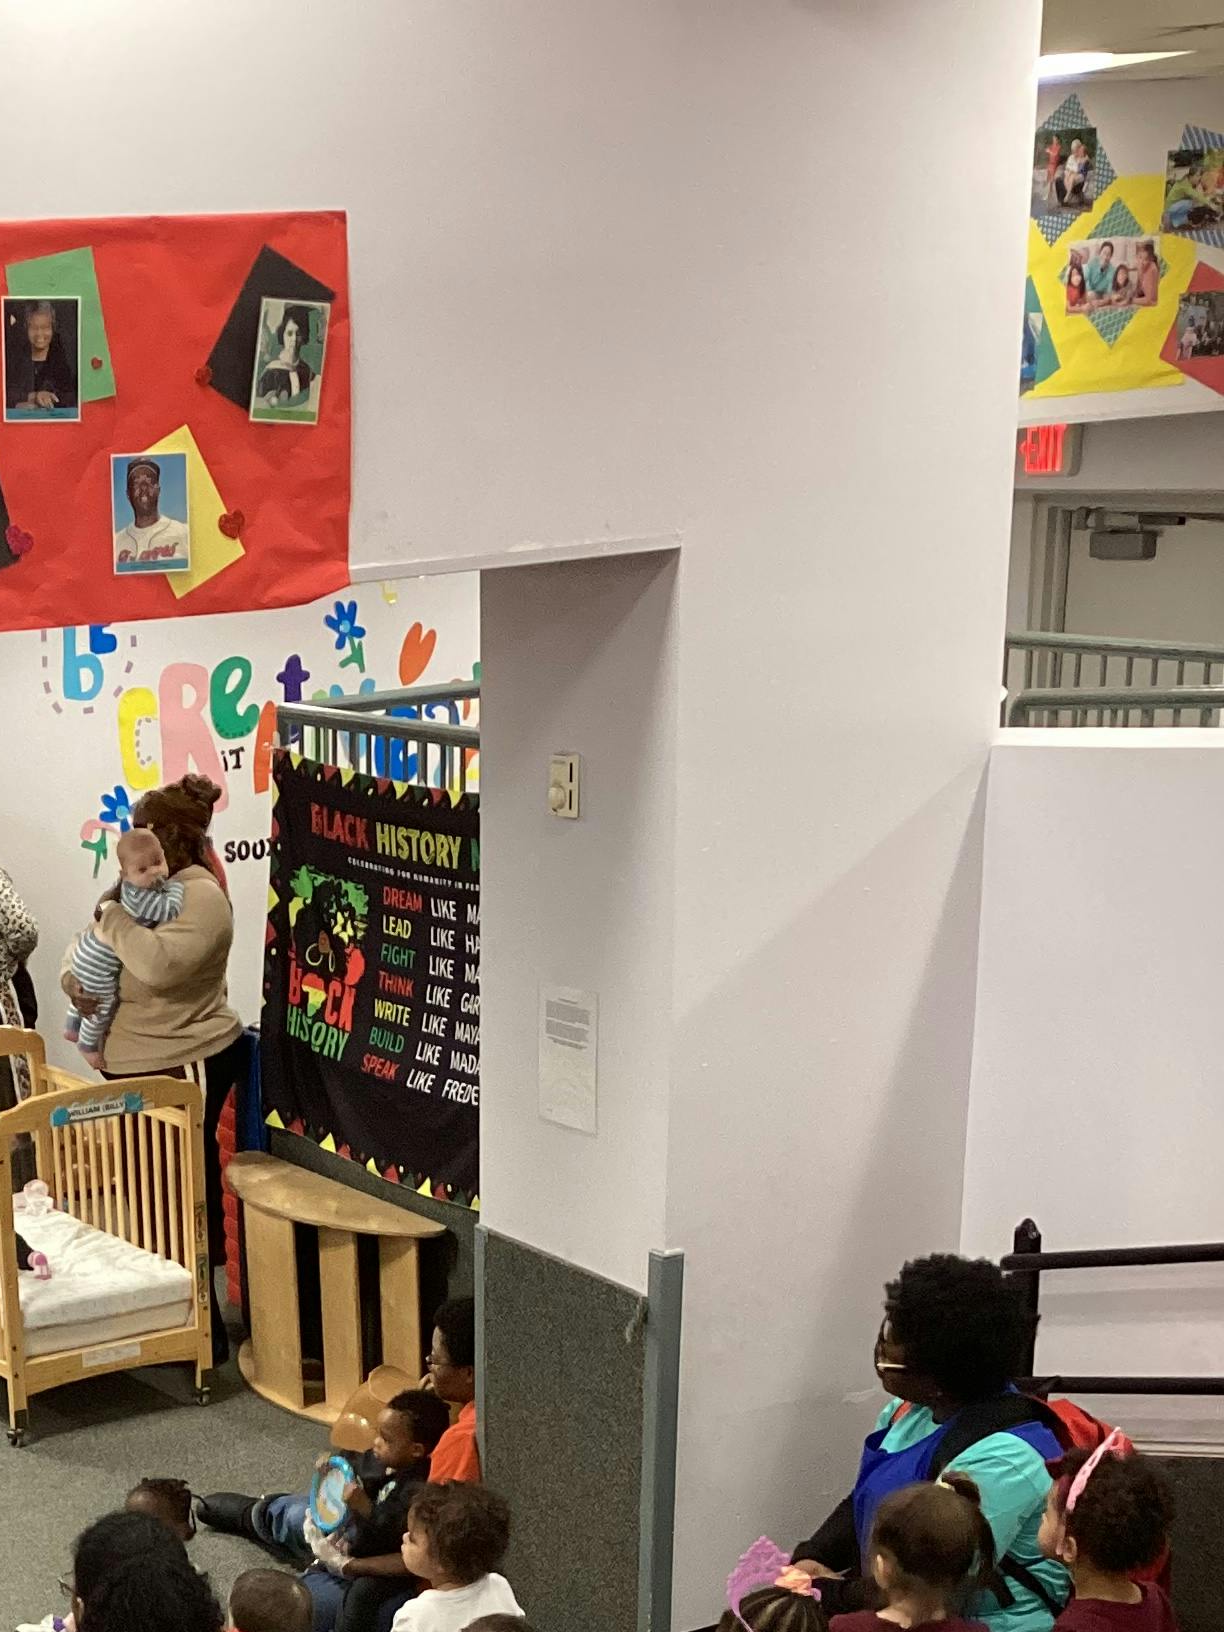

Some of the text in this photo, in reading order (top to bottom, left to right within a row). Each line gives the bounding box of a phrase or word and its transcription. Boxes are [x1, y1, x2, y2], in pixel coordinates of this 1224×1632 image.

[1025, 424, 1066, 472] EXIT
[310, 802, 370, 849] BLACK
[376, 821, 462, 870] HISTORY
[383, 886, 423, 913] DREAM
[430, 897, 457, 921] LIKE
[382, 914, 412, 939] LEAD
[430, 926, 456, 950] LIKE
[381, 943, 416, 969] FIGHT
[429, 955, 455, 979] LIKE
[379, 970, 415, 998] THINK
[426, 984, 453, 1008] LIKE
[374, 998, 412, 1027] WRITE
[421, 1012, 448, 1037] LIKE
[368, 1026, 405, 1053] BUILD
[415, 1040, 443, 1066] LIKE
[361, 1053, 480, 1106] SPEAK LIKE FREDE
